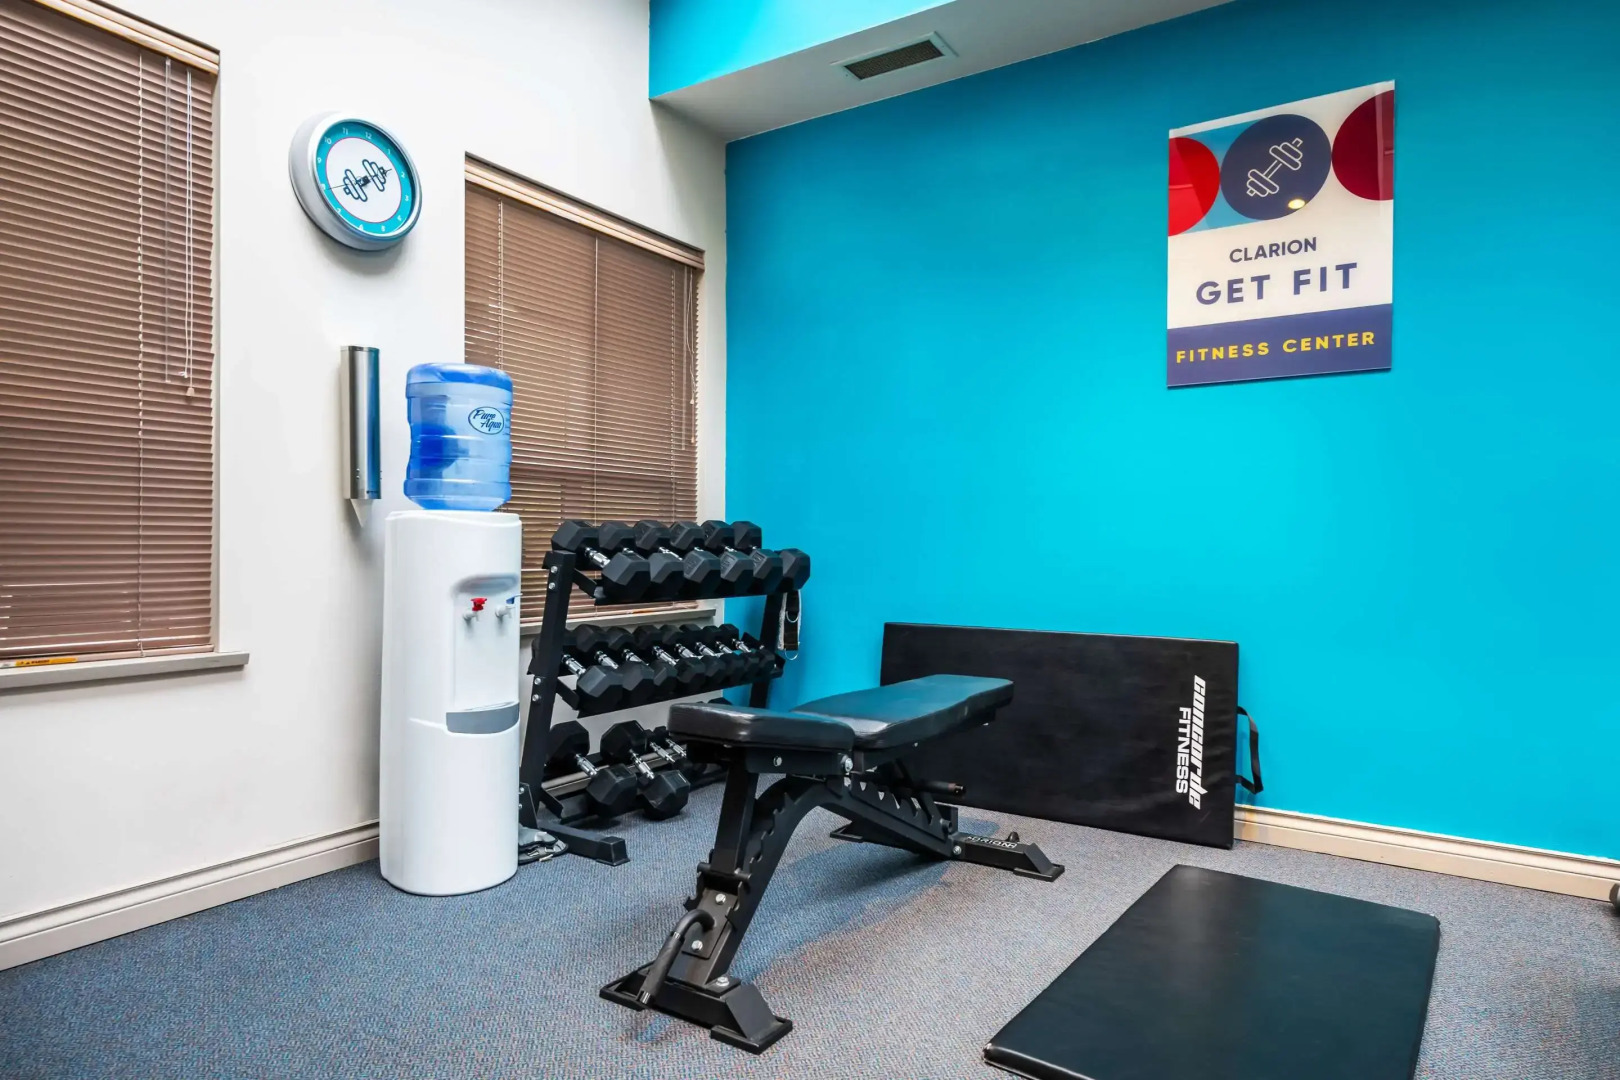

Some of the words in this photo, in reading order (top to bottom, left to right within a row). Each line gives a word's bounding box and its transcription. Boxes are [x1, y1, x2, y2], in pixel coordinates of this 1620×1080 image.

[324, 136, 332, 145] 10
[365, 131, 372, 140] 12
[1230, 237, 1317, 263] CLARION
[1196, 274, 1271, 305] GET
[1294, 262, 1357, 295] FIT
[1176, 342, 1269, 363] FITNESS
[1283, 331, 1375, 353] CENTER
[473, 409, 496, 420] Pure
[480, 418, 502, 432] Aqua
[1176, 706, 1192, 794] FITNESS
